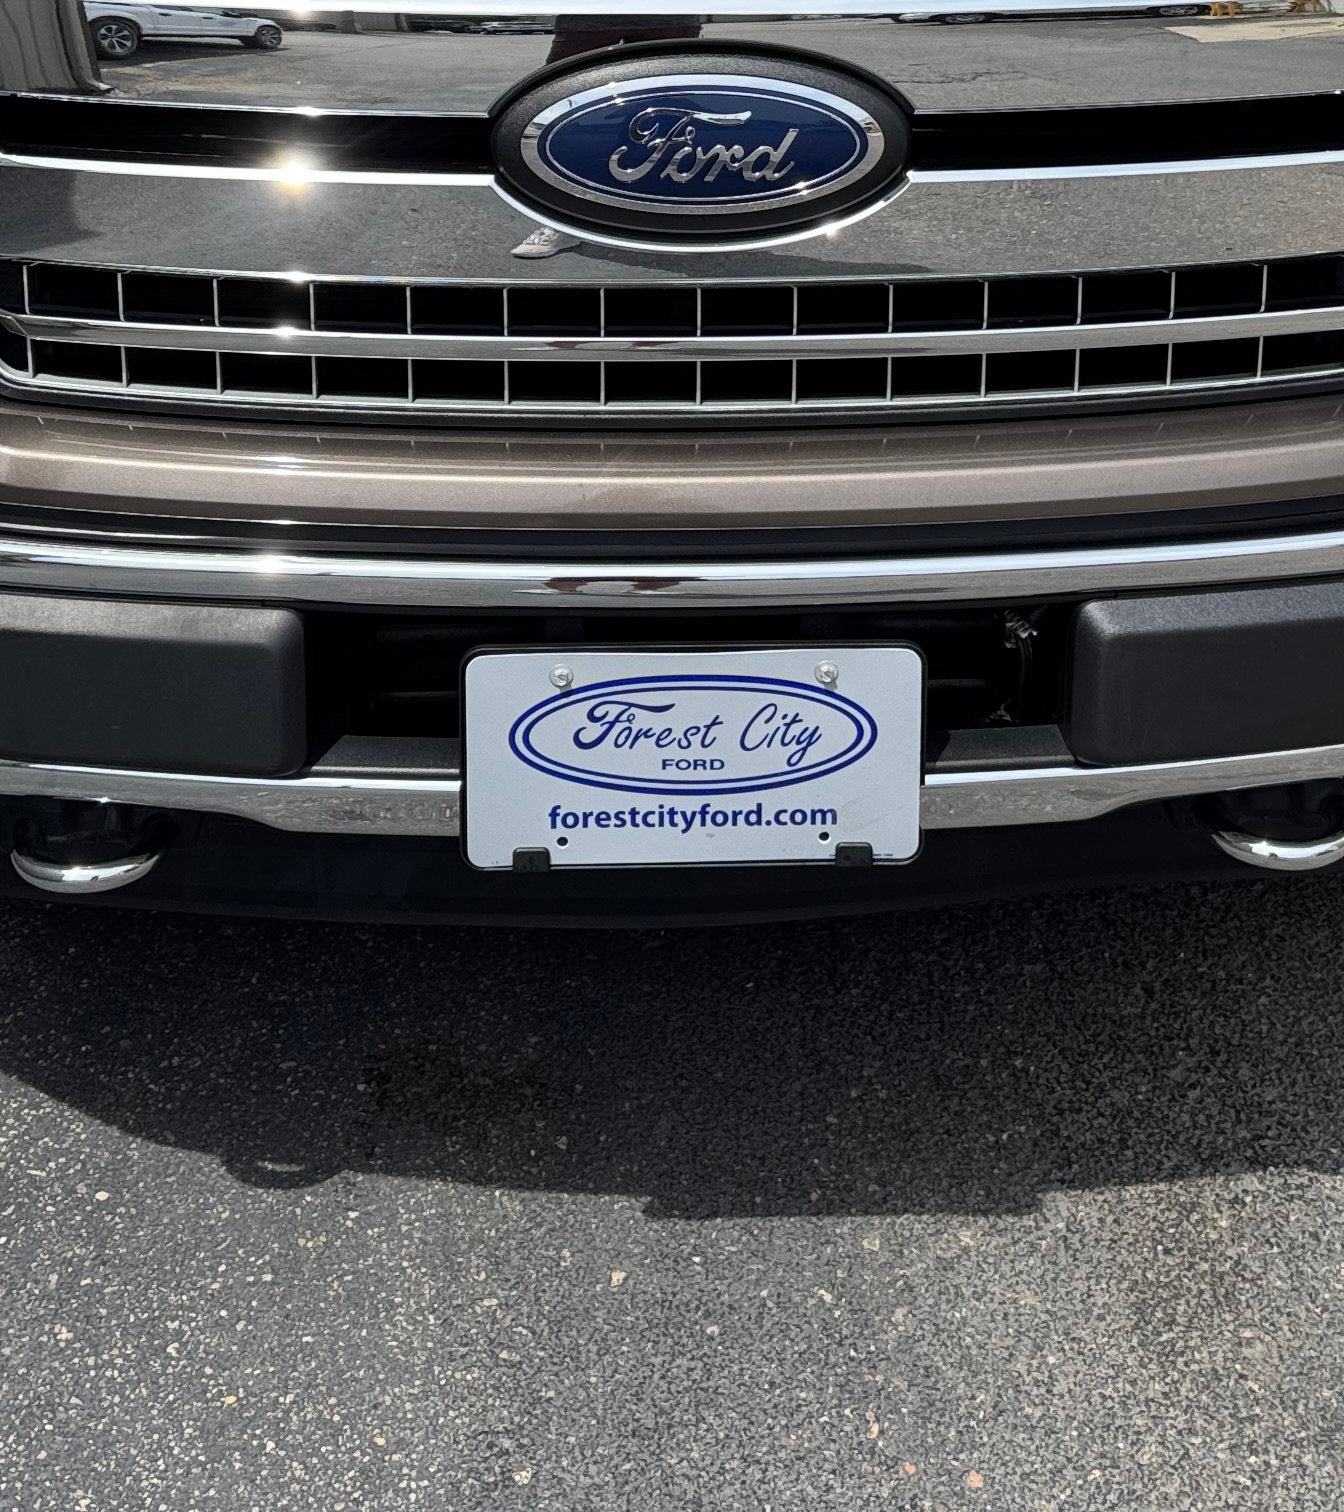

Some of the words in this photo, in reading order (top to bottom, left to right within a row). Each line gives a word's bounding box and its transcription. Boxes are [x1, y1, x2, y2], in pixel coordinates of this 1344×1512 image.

[608, 107, 800, 184] Ford
[572, 700, 724, 750] Forest
[739, 702, 823, 768] City
[661, 758, 726, 772] FORD
[548, 802, 839, 834] forestcityford.com
